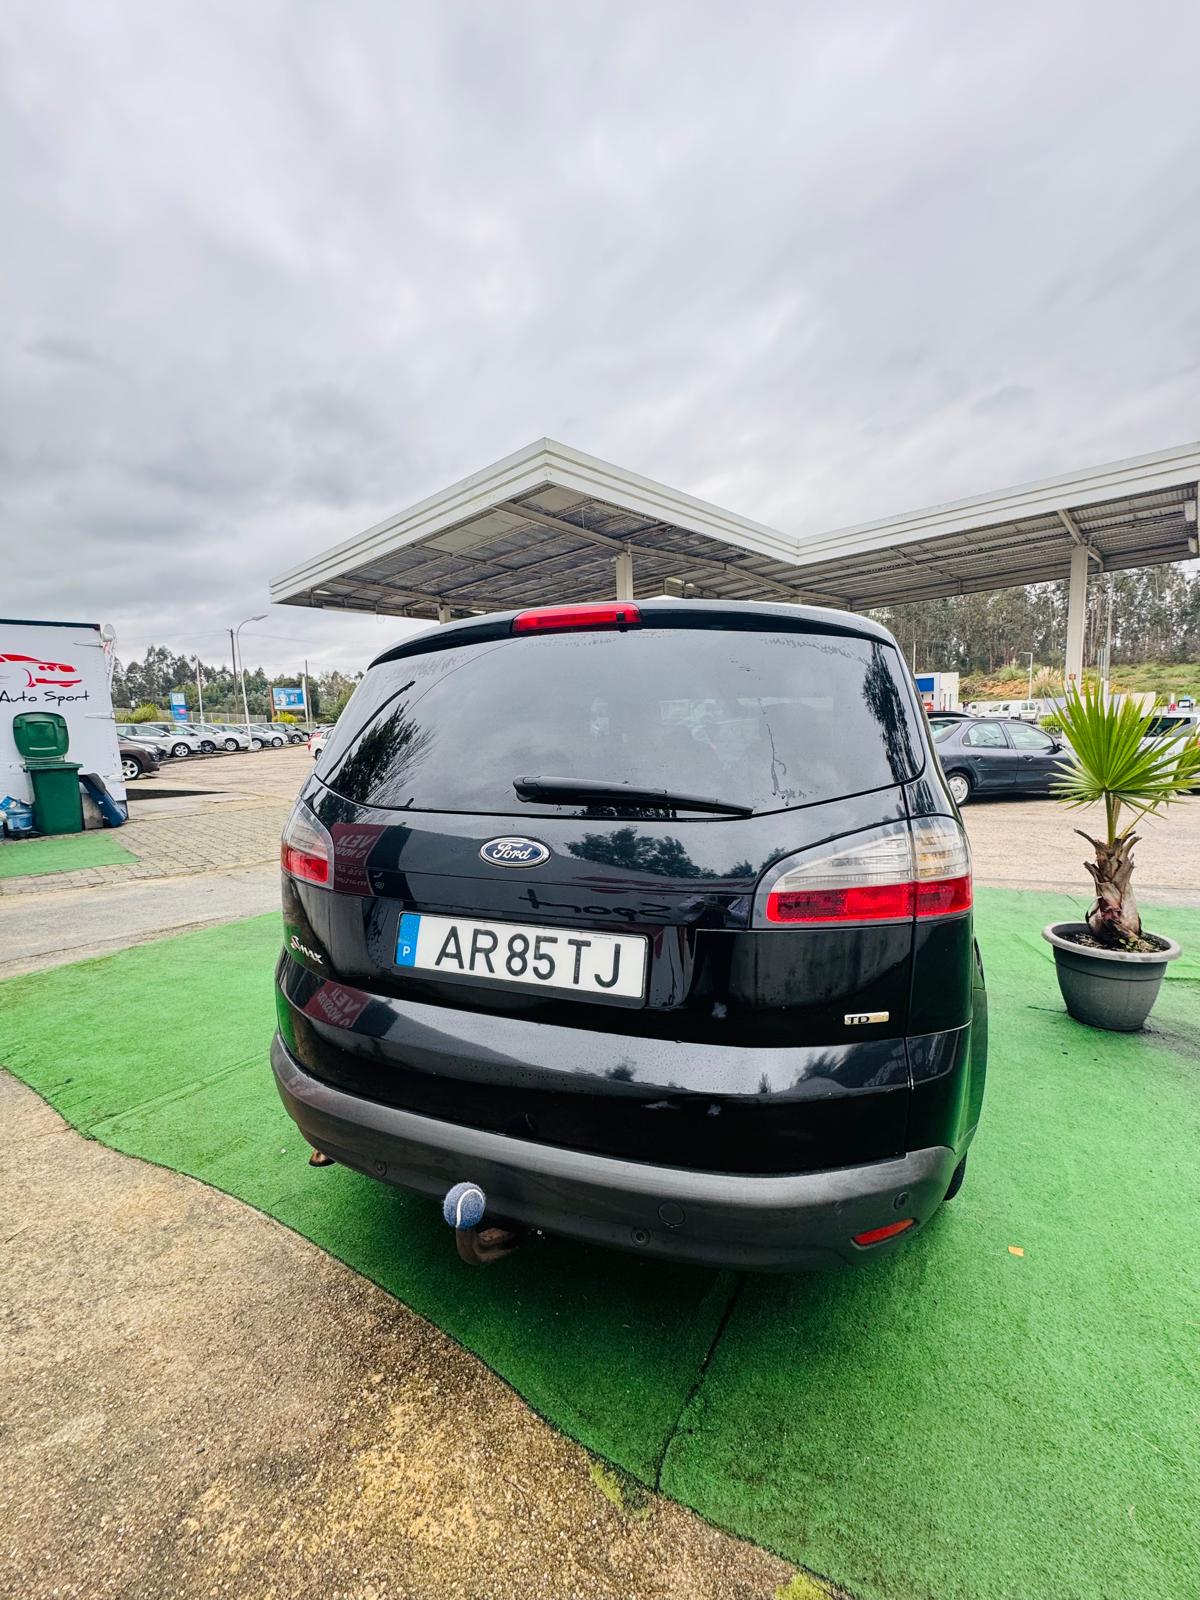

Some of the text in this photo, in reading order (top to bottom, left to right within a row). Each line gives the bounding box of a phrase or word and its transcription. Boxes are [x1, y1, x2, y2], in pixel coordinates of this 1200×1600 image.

[0, 690, 90, 707] Auto Sport
[492, 841, 532, 860] Ford
[402, 946, 411, 957] P
